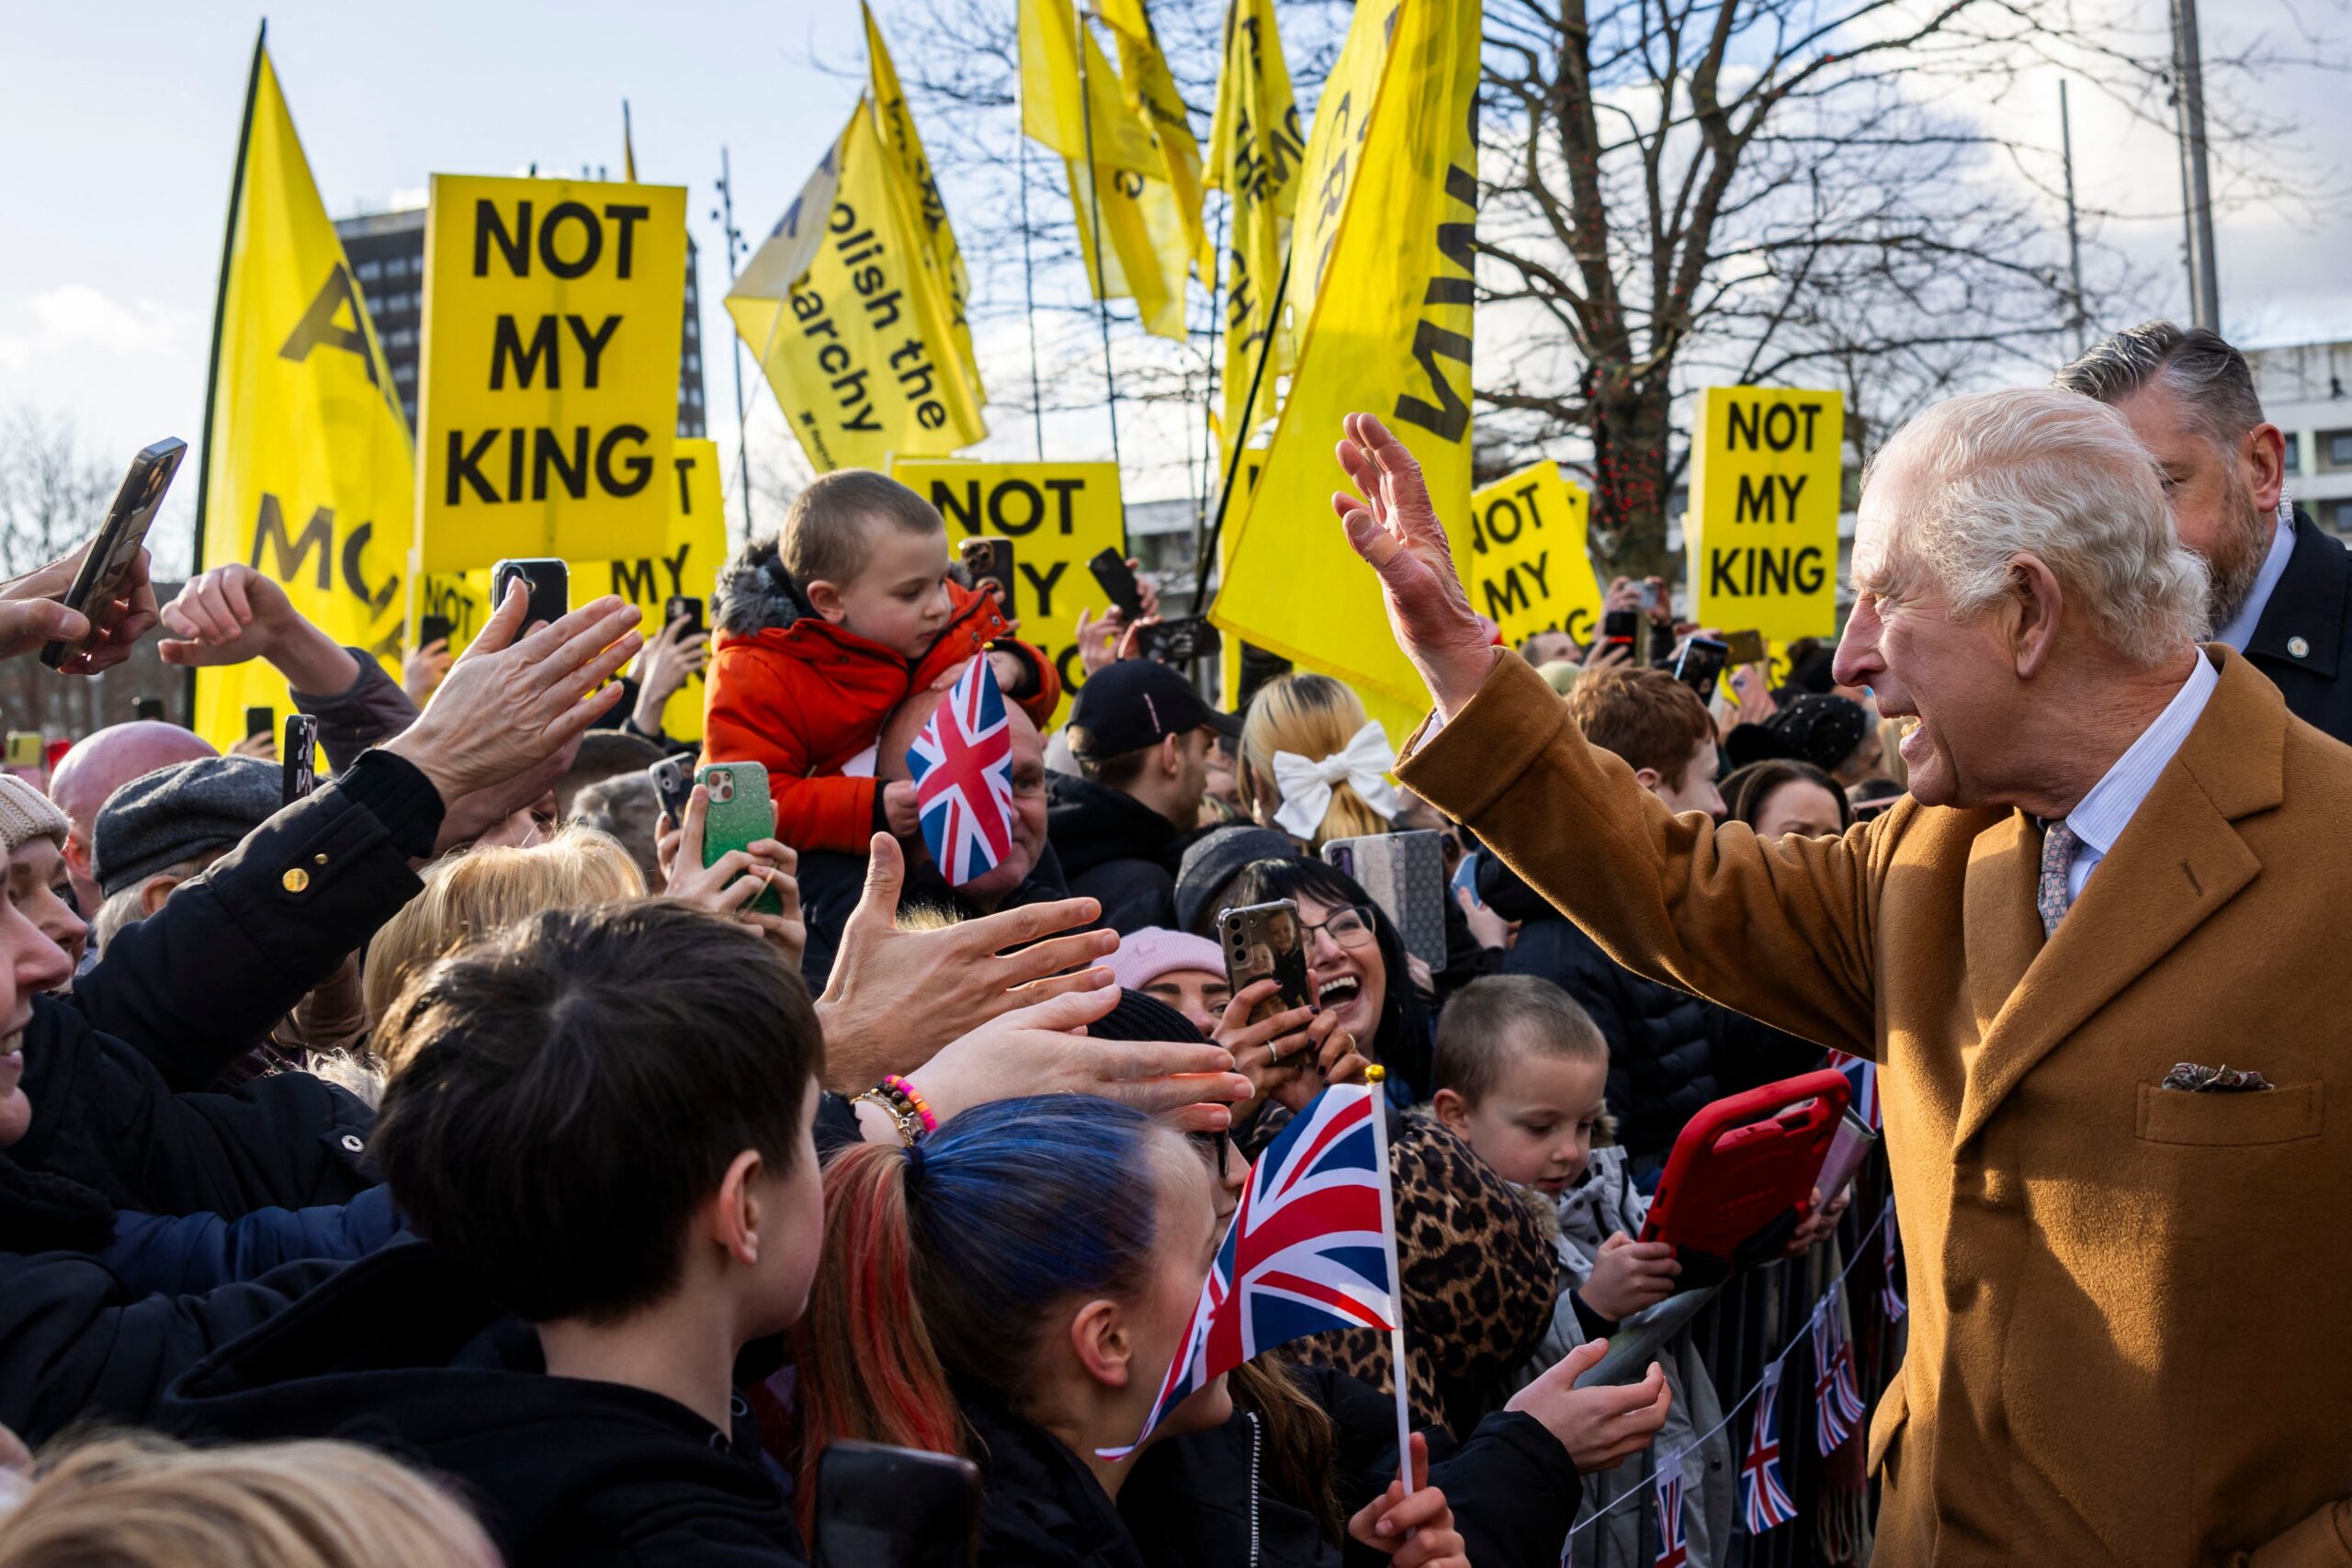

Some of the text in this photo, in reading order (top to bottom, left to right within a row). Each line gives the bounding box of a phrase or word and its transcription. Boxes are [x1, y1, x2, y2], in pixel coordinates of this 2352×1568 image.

[474, 199, 650, 279] NOT
[828, 203, 947, 430] olish the
[489, 314, 623, 390] MY
[1726, 401, 1822, 452] NOT
[446, 424, 653, 506] KING
[931, 479, 1085, 536] NOT
[1736, 474, 1808, 524] MY
[611, 544, 690, 604] MY
[1483, 550, 1549, 623] MY
[1711, 547, 1825, 597] KING
